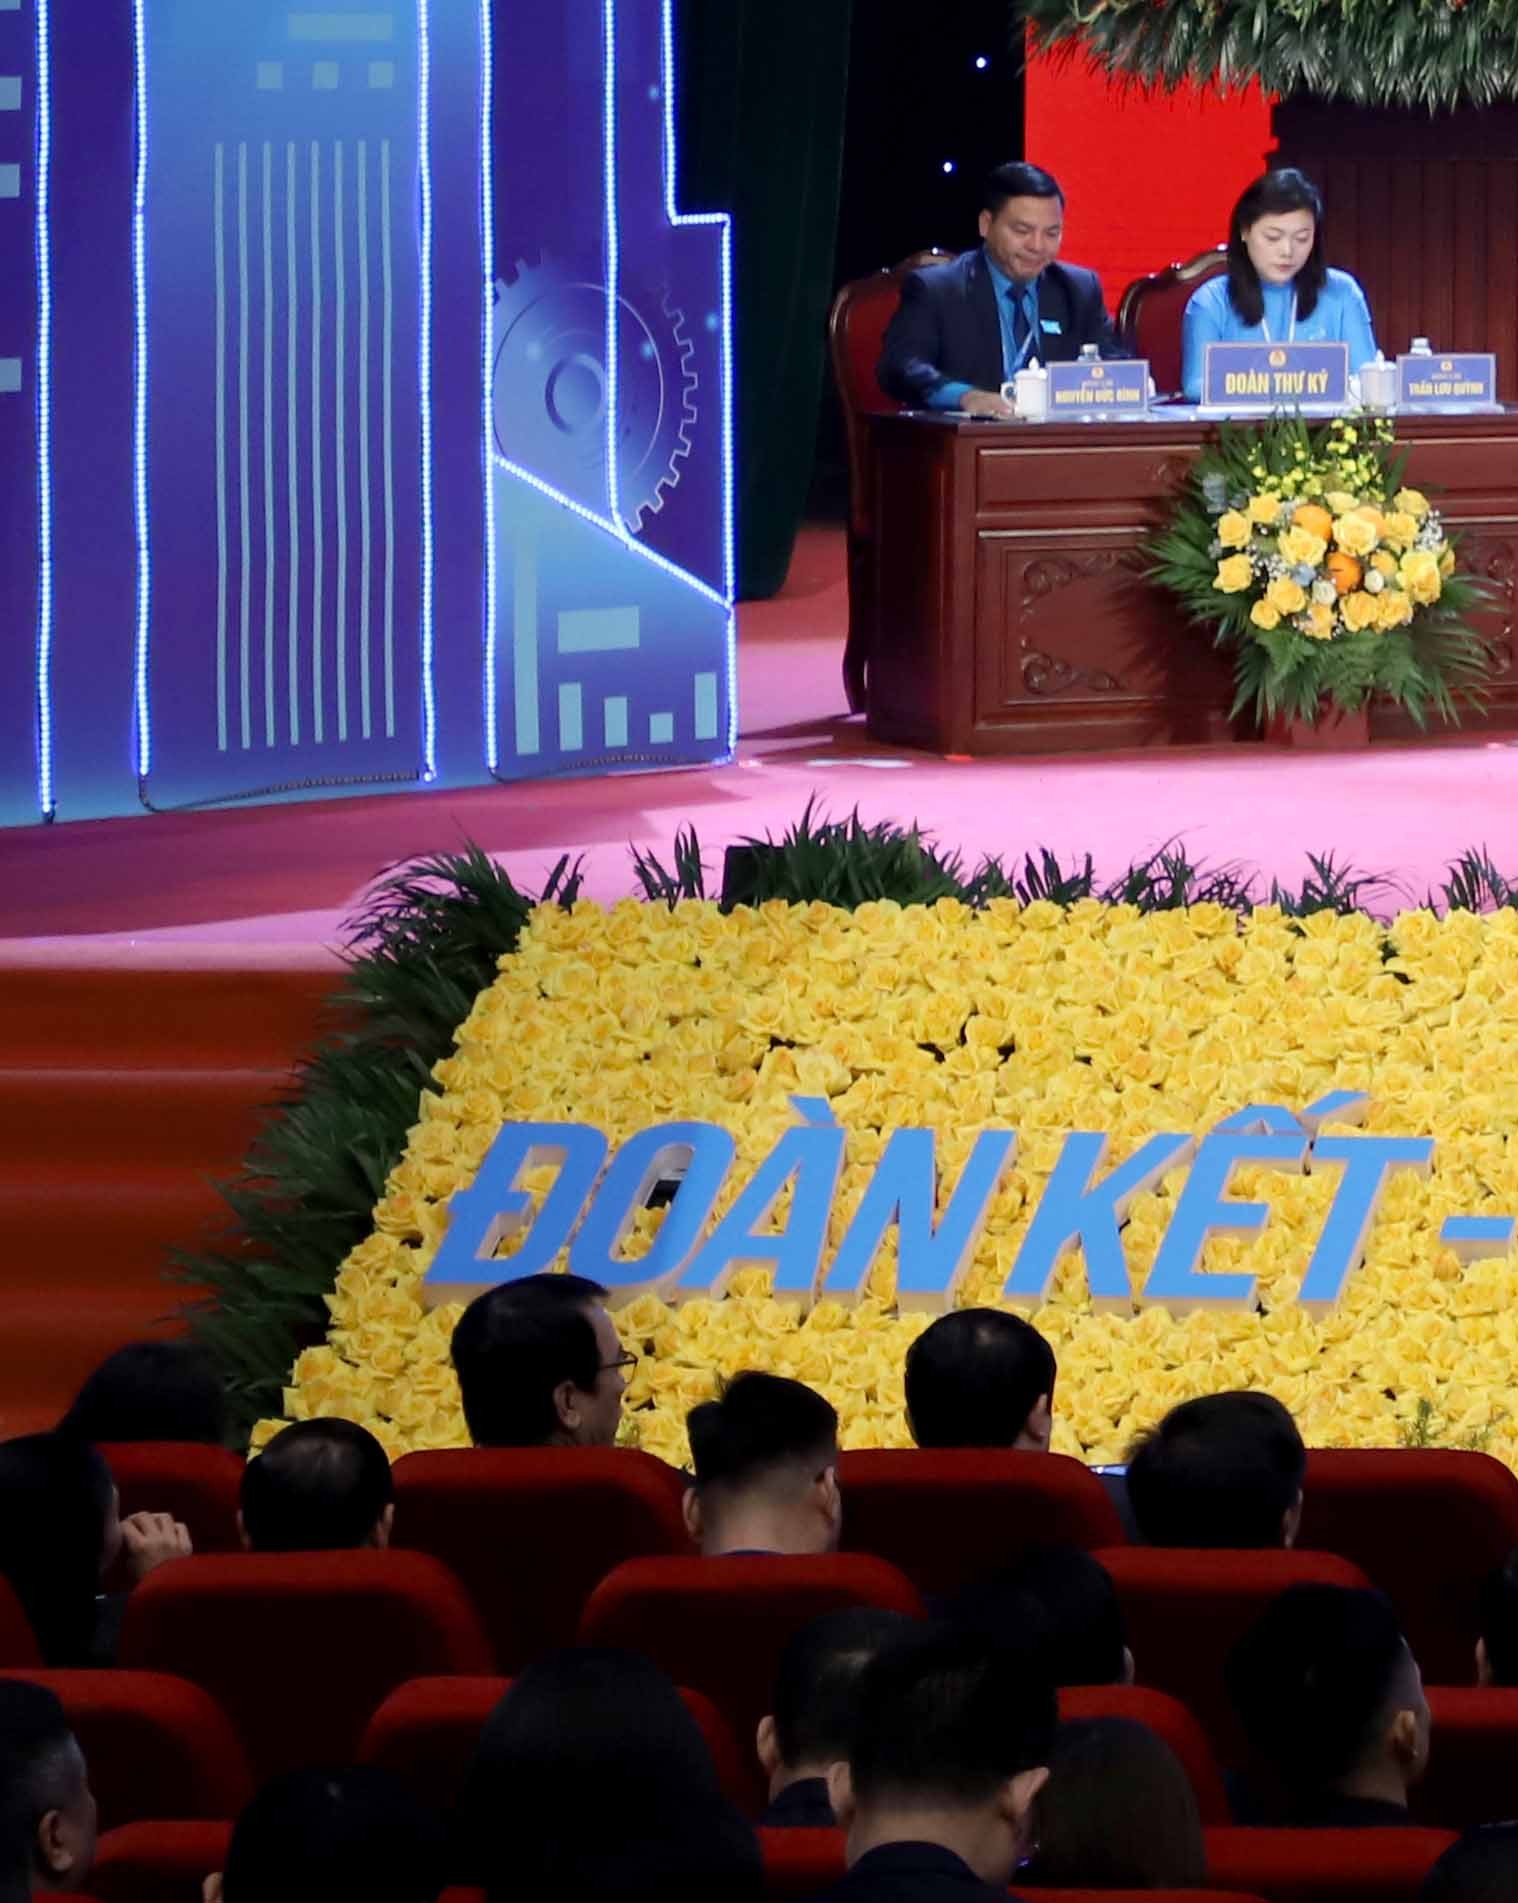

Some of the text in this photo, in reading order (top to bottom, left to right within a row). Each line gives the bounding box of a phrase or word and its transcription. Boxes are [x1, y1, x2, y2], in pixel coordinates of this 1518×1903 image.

[1225, 368, 1269, 394] ĐOÀN
[1273, 369, 1306, 394] THƯ
[424, 1096, 1014, 1298] ĐOÀN
[1004, 1092, 1434, 1306] KẾT
